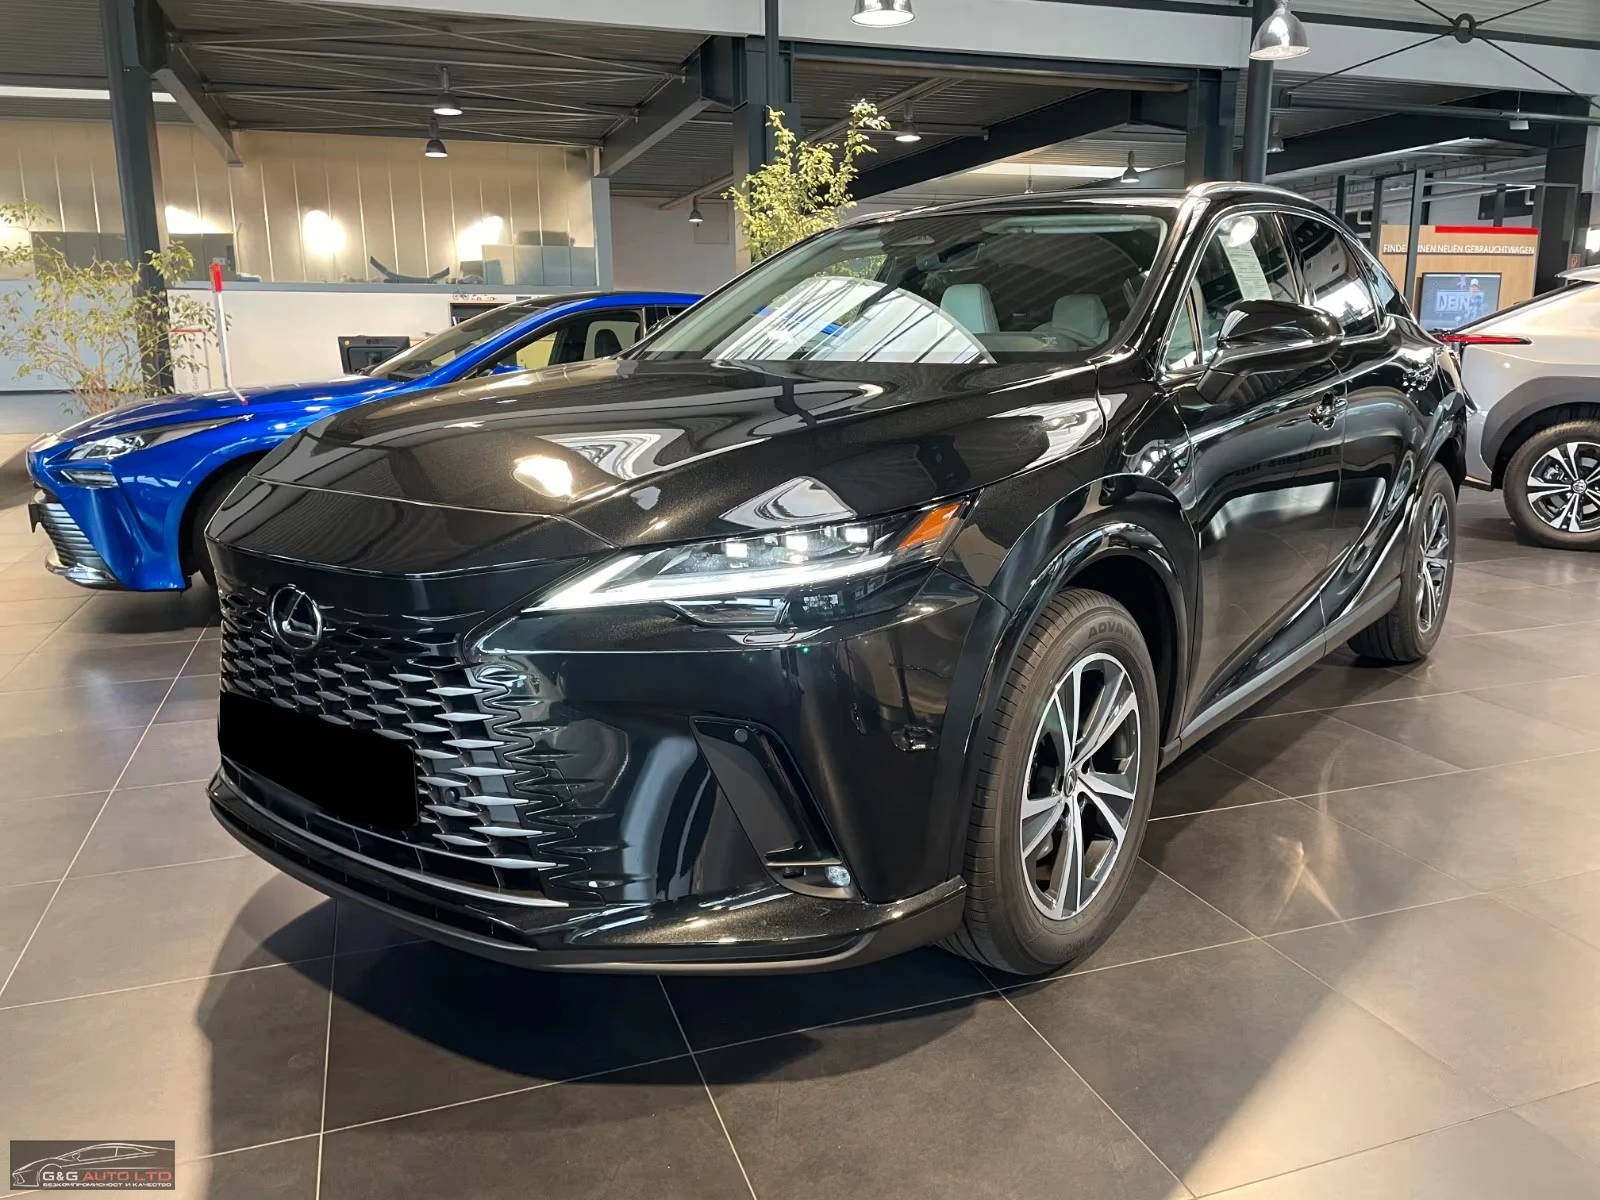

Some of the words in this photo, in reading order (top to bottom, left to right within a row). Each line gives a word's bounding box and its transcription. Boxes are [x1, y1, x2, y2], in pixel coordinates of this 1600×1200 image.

[1417, 245, 1436, 254] INEN
[1438, 245, 1463, 254] NEUEN
[1465, 245, 1535, 254] GEBRAUCHTWAGEN
